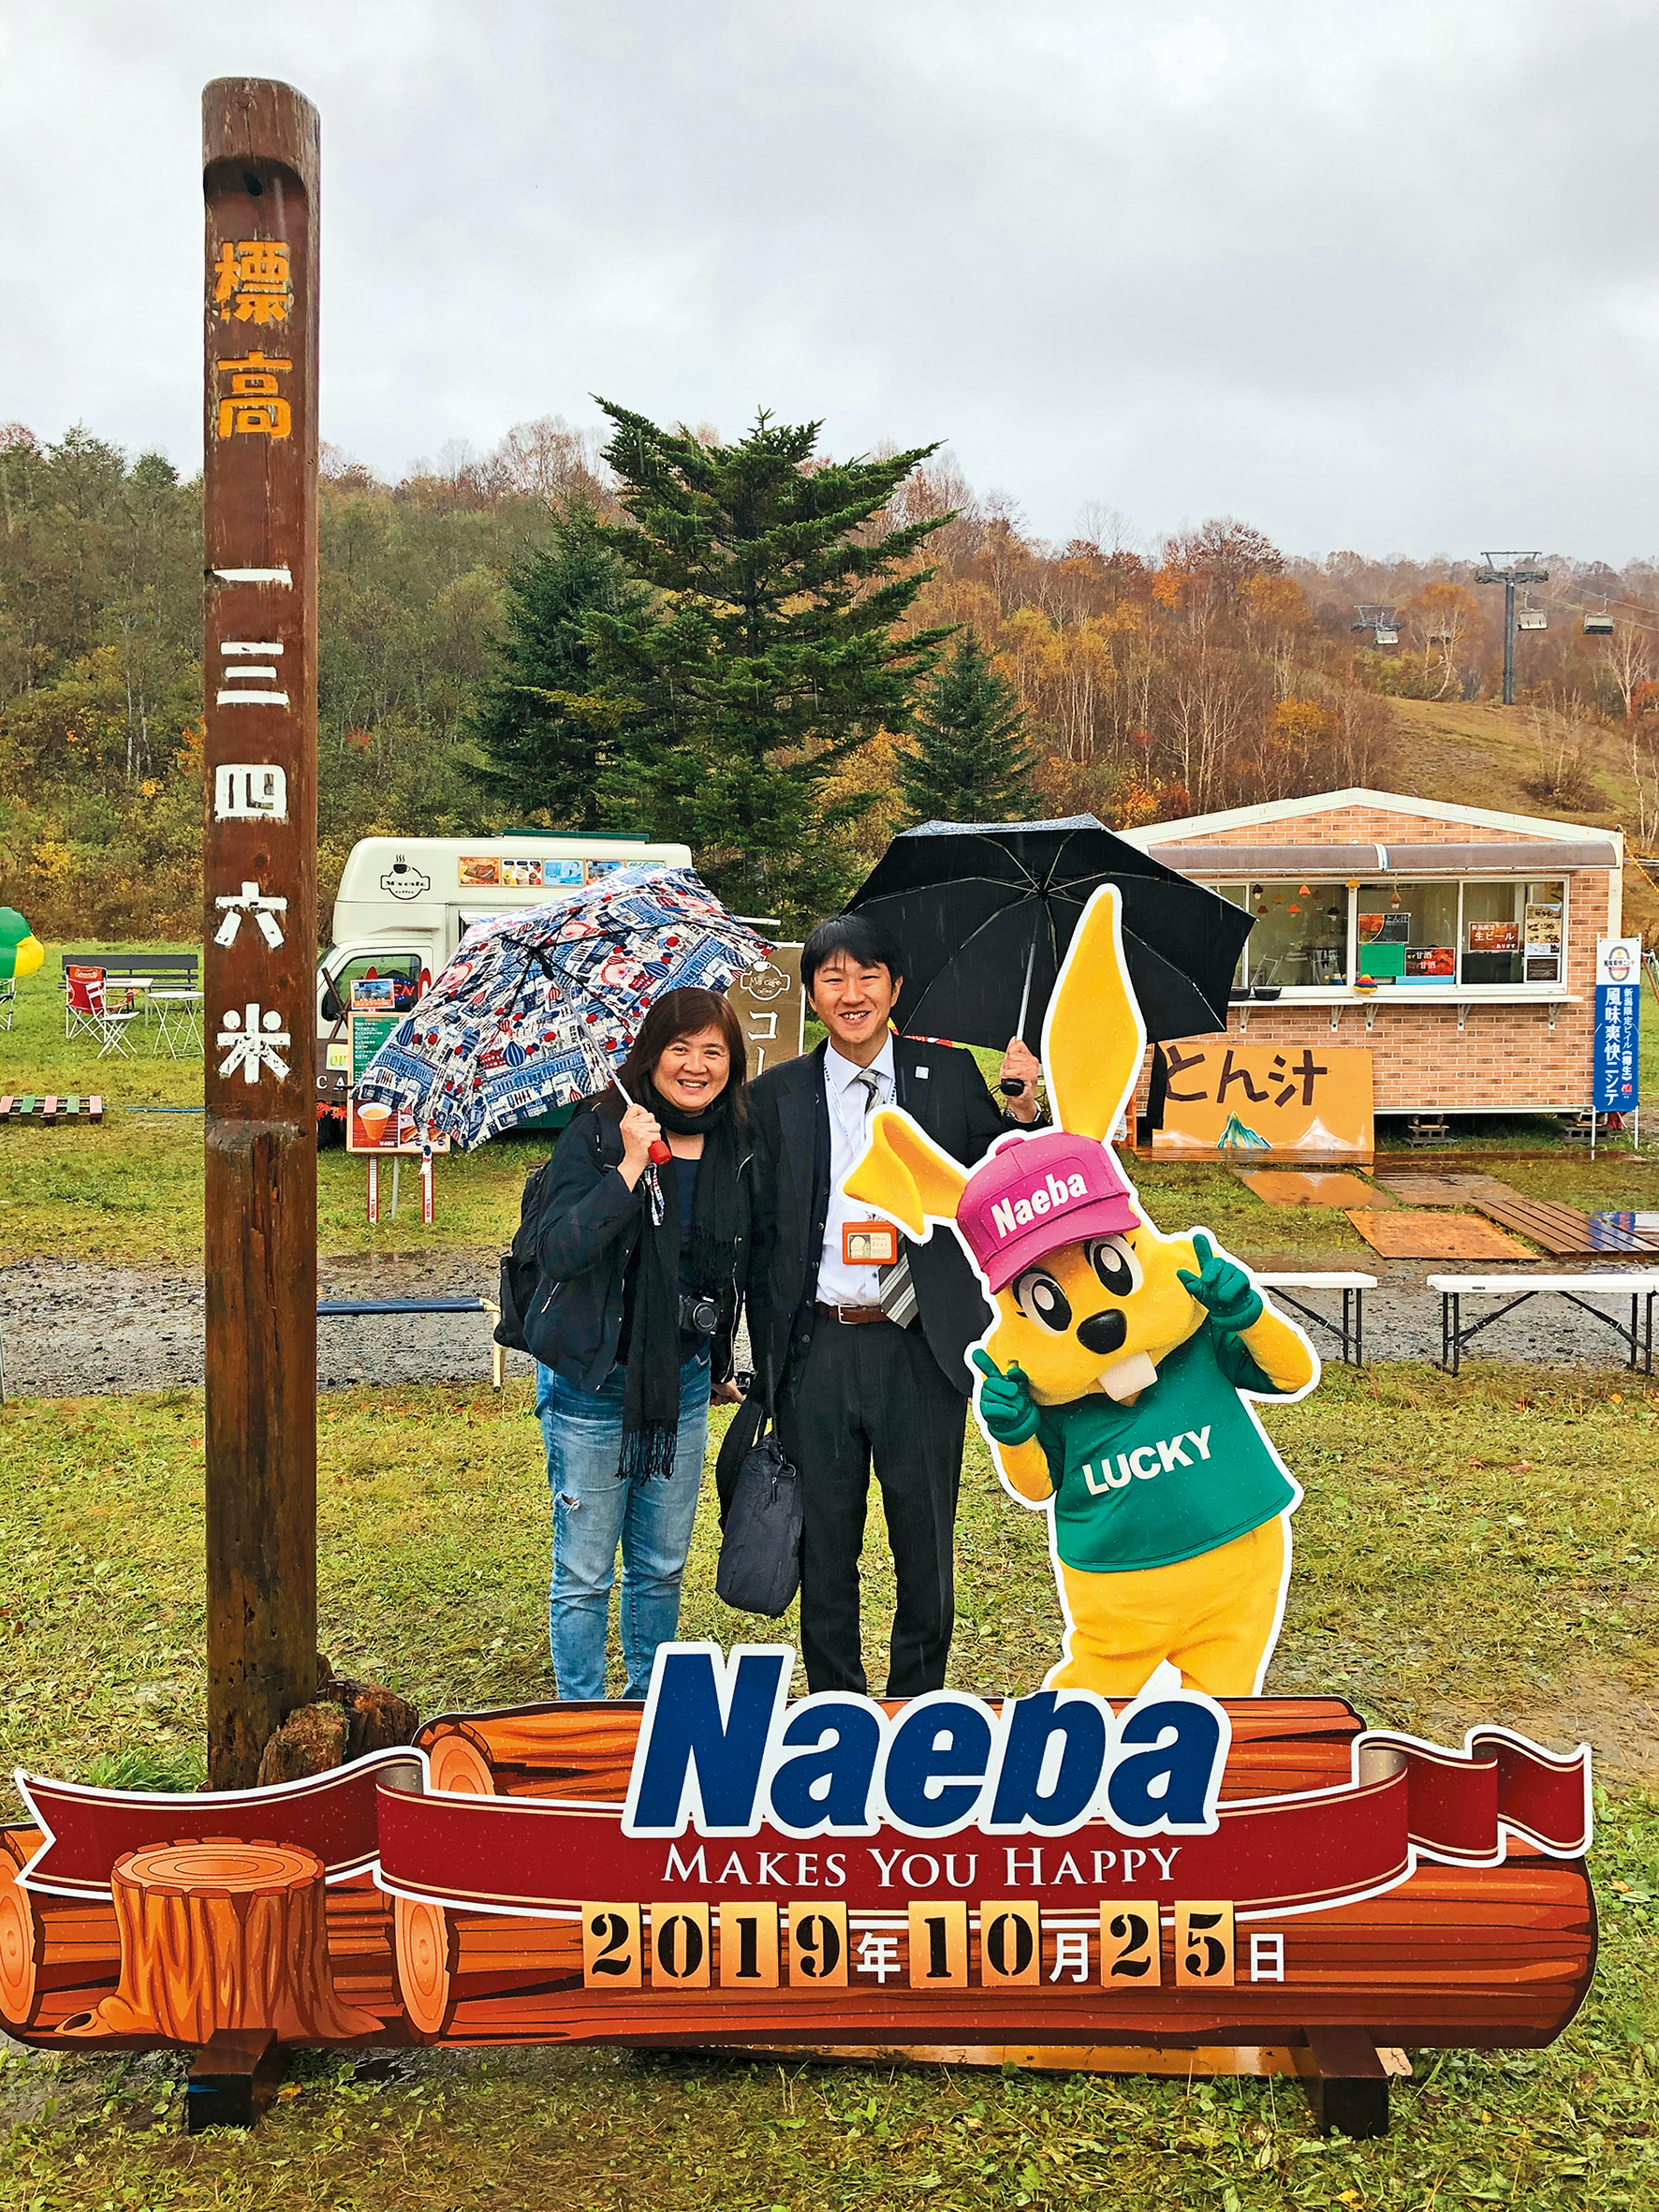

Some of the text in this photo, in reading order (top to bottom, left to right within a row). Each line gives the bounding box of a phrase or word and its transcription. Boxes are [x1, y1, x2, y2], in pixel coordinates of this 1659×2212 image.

[213, 240, 294, 1084] 標高 一三四六米
[1474, 931, 1515, 941] 生ビール
[747, 1010, 779, 1078] コー
[1167, 1044, 1328, 1107] とん汁
[1604, 987, 1622, 1106] 風味爽快ニシテ
[990, 1168, 1088, 1239] Naeba
[1081, 1425, 1212, 1496] LUCKY
[629, 1650, 1223, 1831] Naeba
[589, 1911, 1285, 1983] 2019年10月25日
